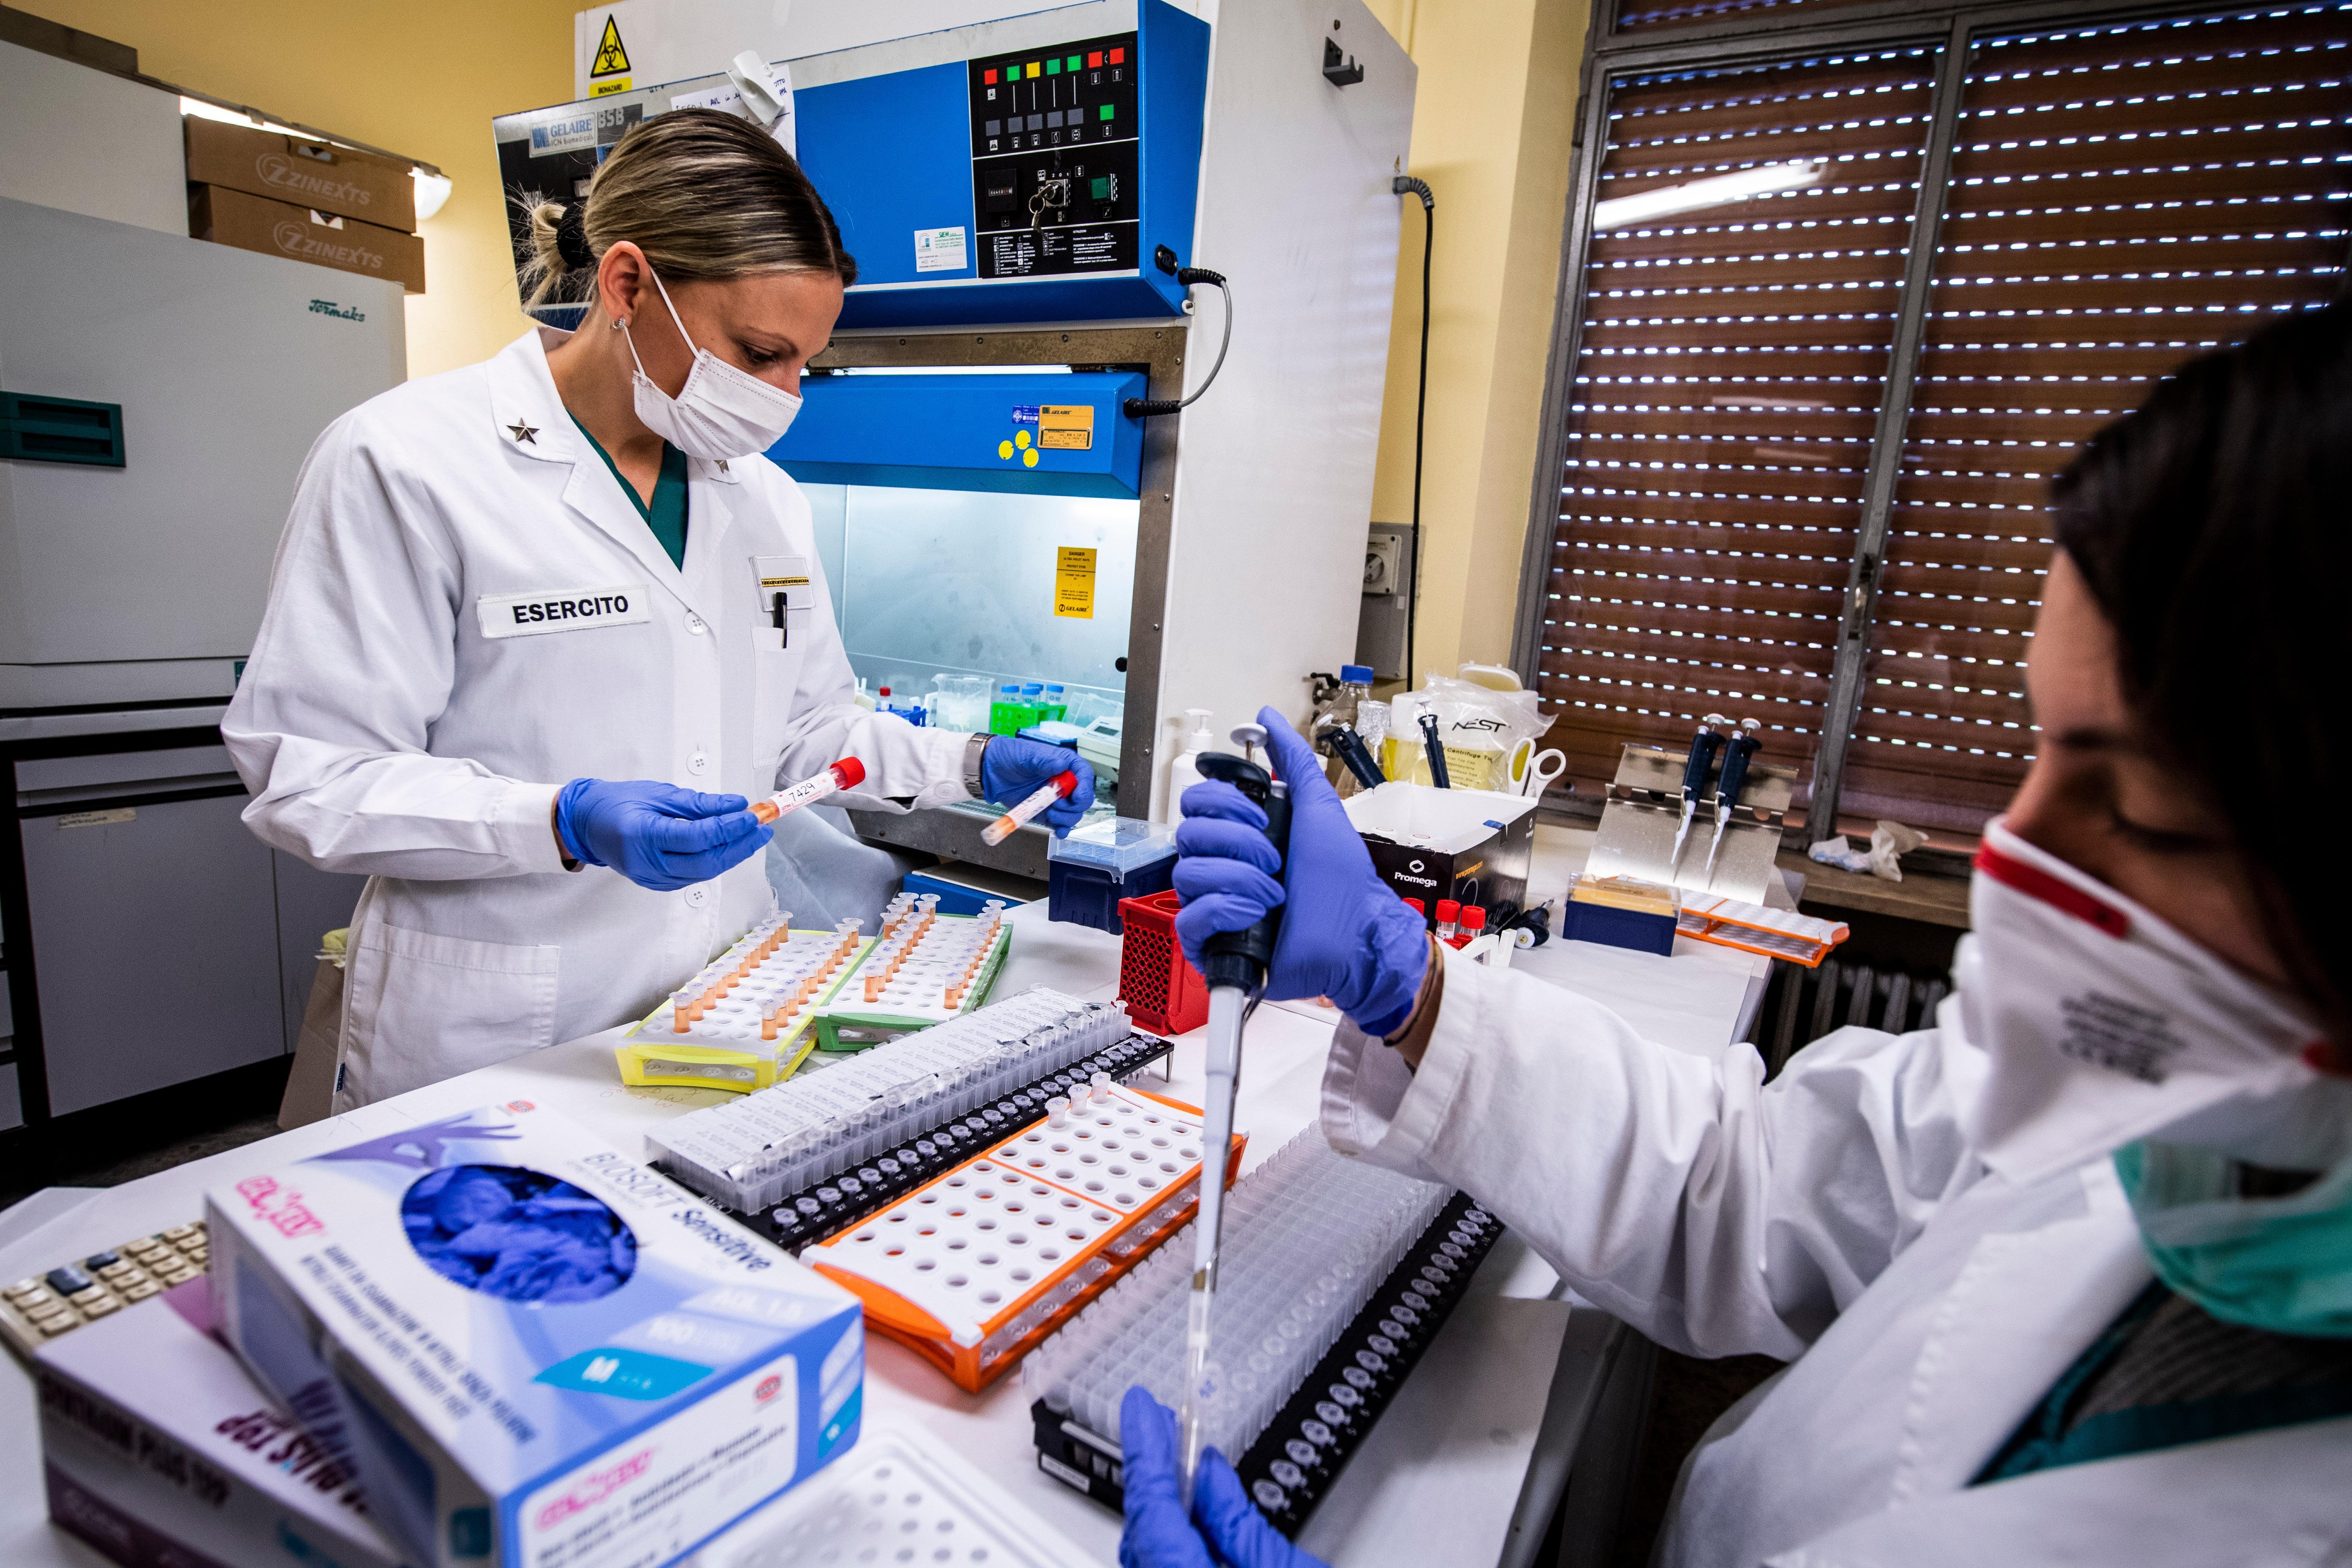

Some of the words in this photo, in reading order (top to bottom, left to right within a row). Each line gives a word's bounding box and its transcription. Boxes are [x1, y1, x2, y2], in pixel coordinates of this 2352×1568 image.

[598, 84, 622, 94] BIOHAZARD
[550, 118, 592, 137] GELAIRE
[598, 107, 624, 128] BSB
[563, 133, 593, 145] Biomedicals
[286, 171, 370, 206] ZINEXTS
[303, 238, 382, 269] ZINEXTS
[512, 595, 629, 624] ESERCITO
[1452, 719, 1507, 732] NEST
[1447, 747, 1481, 759] Centrifuge
[789, 783, 816, 801] 7429
[1394, 871, 1437, 887] Promega
[1456, 860, 1483, 879] www.promega.com
[583, 1151, 690, 1208] BIOSOFT
[790, 1225, 805, 1234] 25
[813, 1214, 827, 1222] 26
[835, 1203, 847, 1212] 27
[672, 1208, 772, 1272] Sensitive
[646, 1317, 697, 1344] 100
[582, 1355, 620, 1383] M
